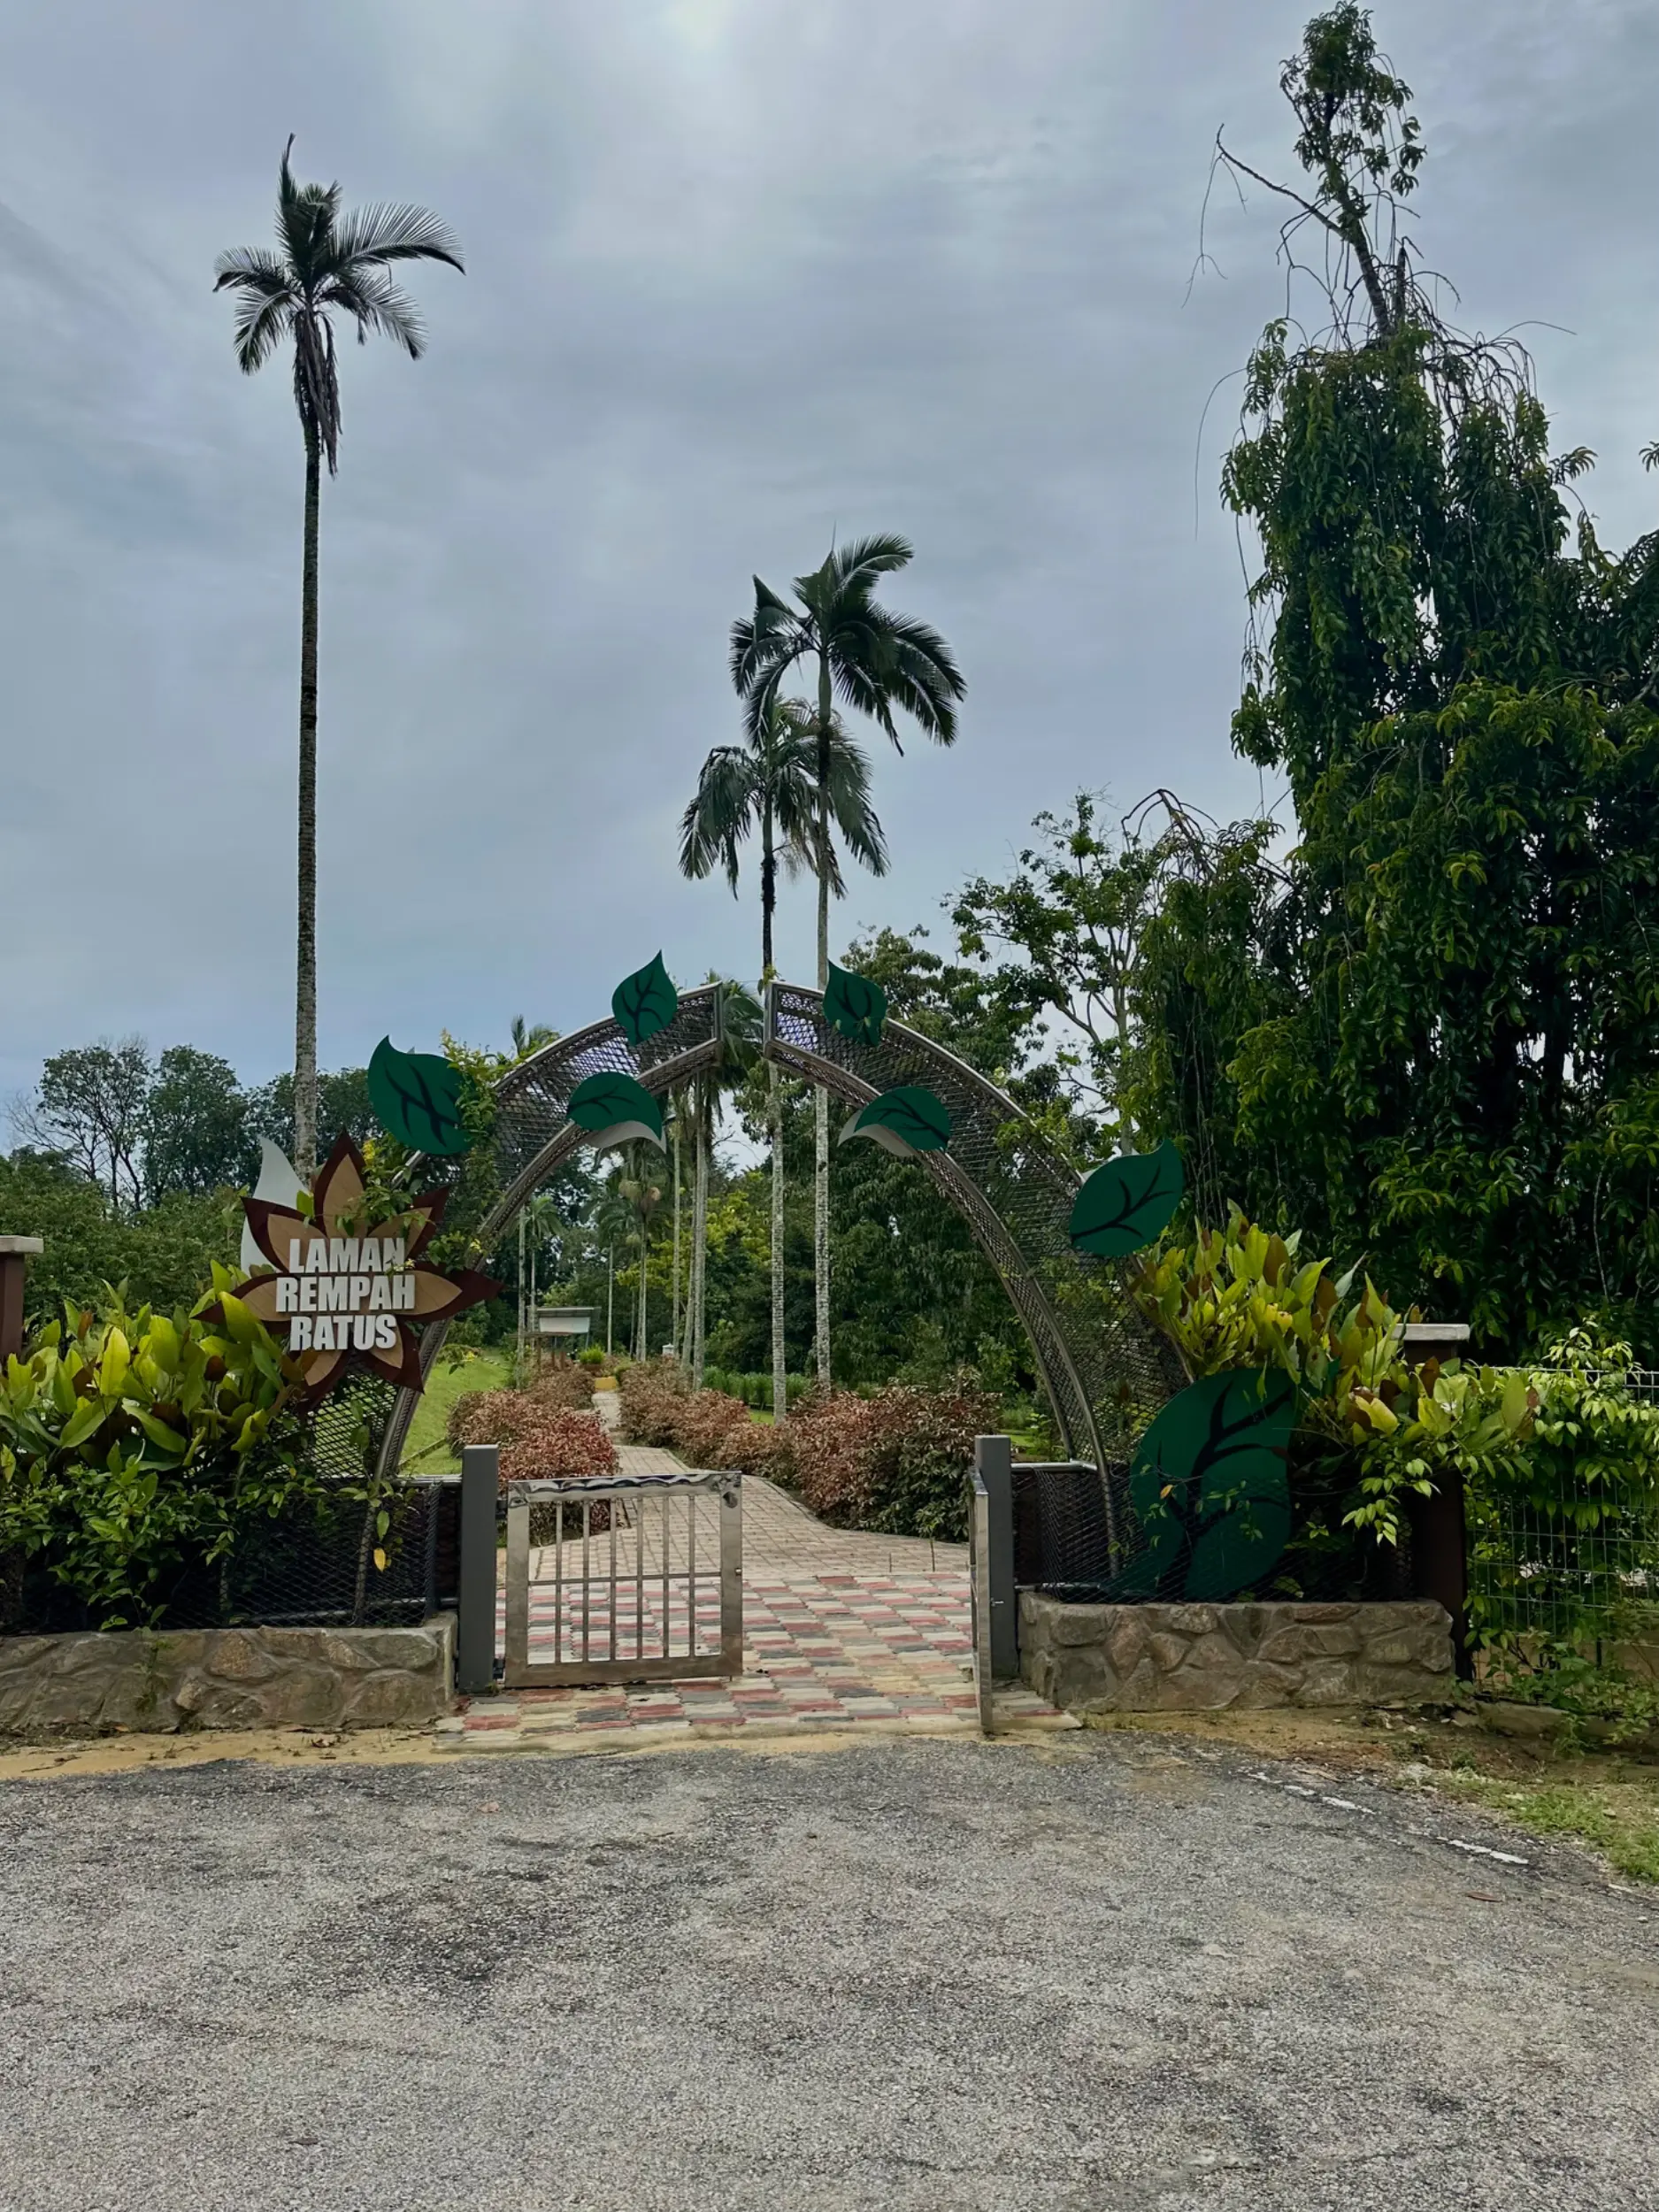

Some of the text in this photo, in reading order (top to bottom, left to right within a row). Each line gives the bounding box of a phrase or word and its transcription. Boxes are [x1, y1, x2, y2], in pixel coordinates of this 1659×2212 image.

[289, 1238, 405, 1273] LAMAN
[276, 1275, 415, 1312] REMPAH
[289, 1314, 397, 1351] RATUS
